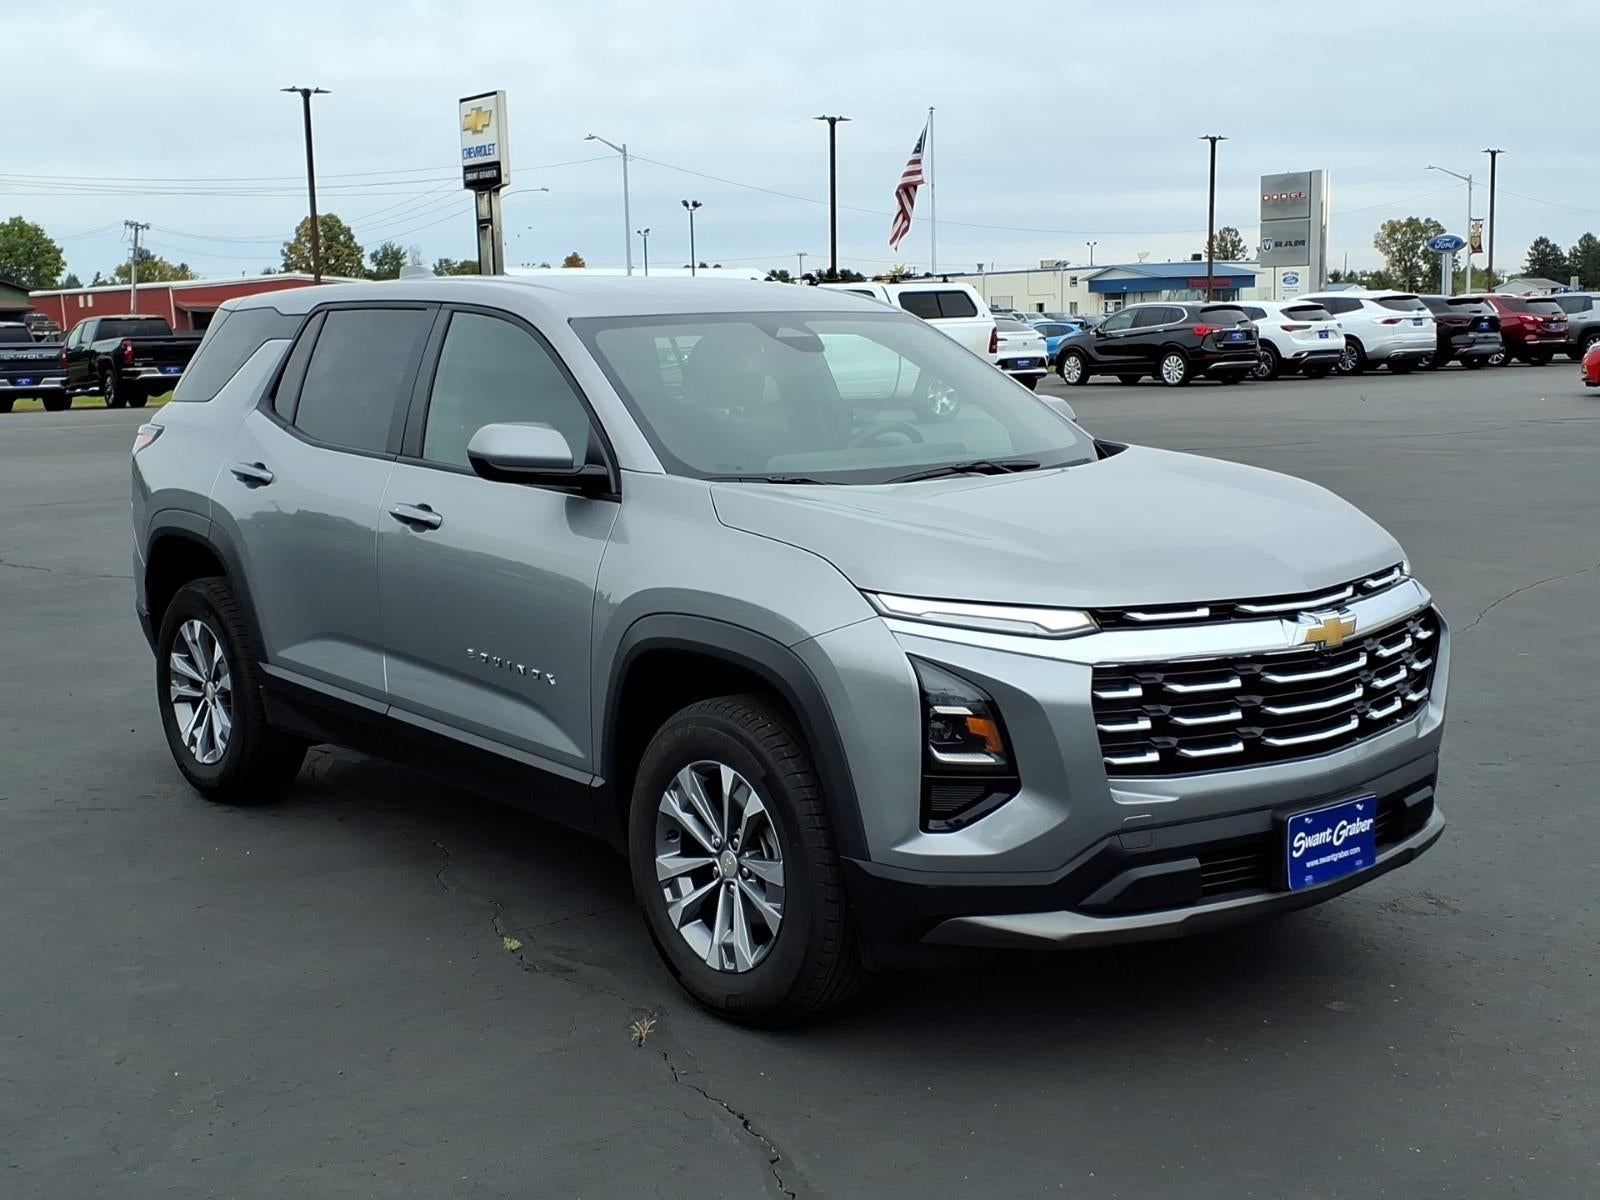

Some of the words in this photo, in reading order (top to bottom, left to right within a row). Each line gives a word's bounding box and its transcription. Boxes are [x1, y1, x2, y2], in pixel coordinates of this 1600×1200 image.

[463, 143, 496, 160] CHEVROLET
[1262, 191, 1307, 202] DODGE
[1274, 239, 1306, 249] RAM
[1434, 238, 1456, 249] Ford
[466, 648, 556, 686] EQUINOX
[1292, 827, 1333, 858] Swart
[1332, 817, 1374, 846] Graber
